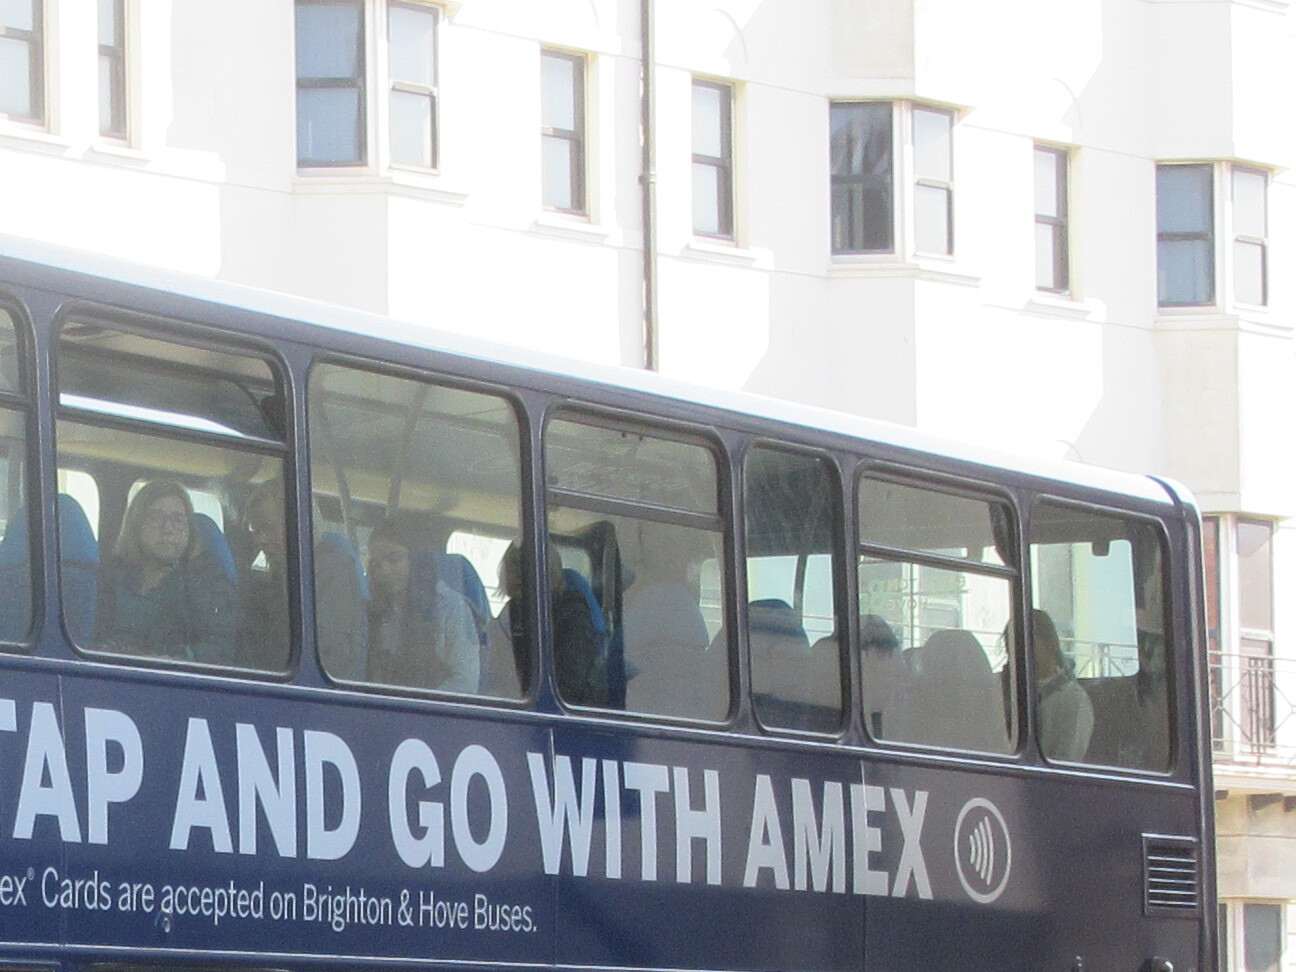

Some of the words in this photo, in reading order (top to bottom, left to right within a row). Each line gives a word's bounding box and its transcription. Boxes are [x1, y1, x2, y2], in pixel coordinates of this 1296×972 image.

[169, 717, 362, 860] AND
[389, 739, 508, 873] GO
[527, 752, 722, 888] WITH
[743, 774, 934, 900] AMEX
[42, 867, 112, 911] Cards
[118, 882, 154, 912] are
[160, 880, 264, 925] accepted
[270, 891, 296, 920] on
[304, 883, 392, 931] Brighton
[397, 889, 414, 927] &
[420, 891, 468, 928] Hove
[475, 894, 537, 932] Buses.
